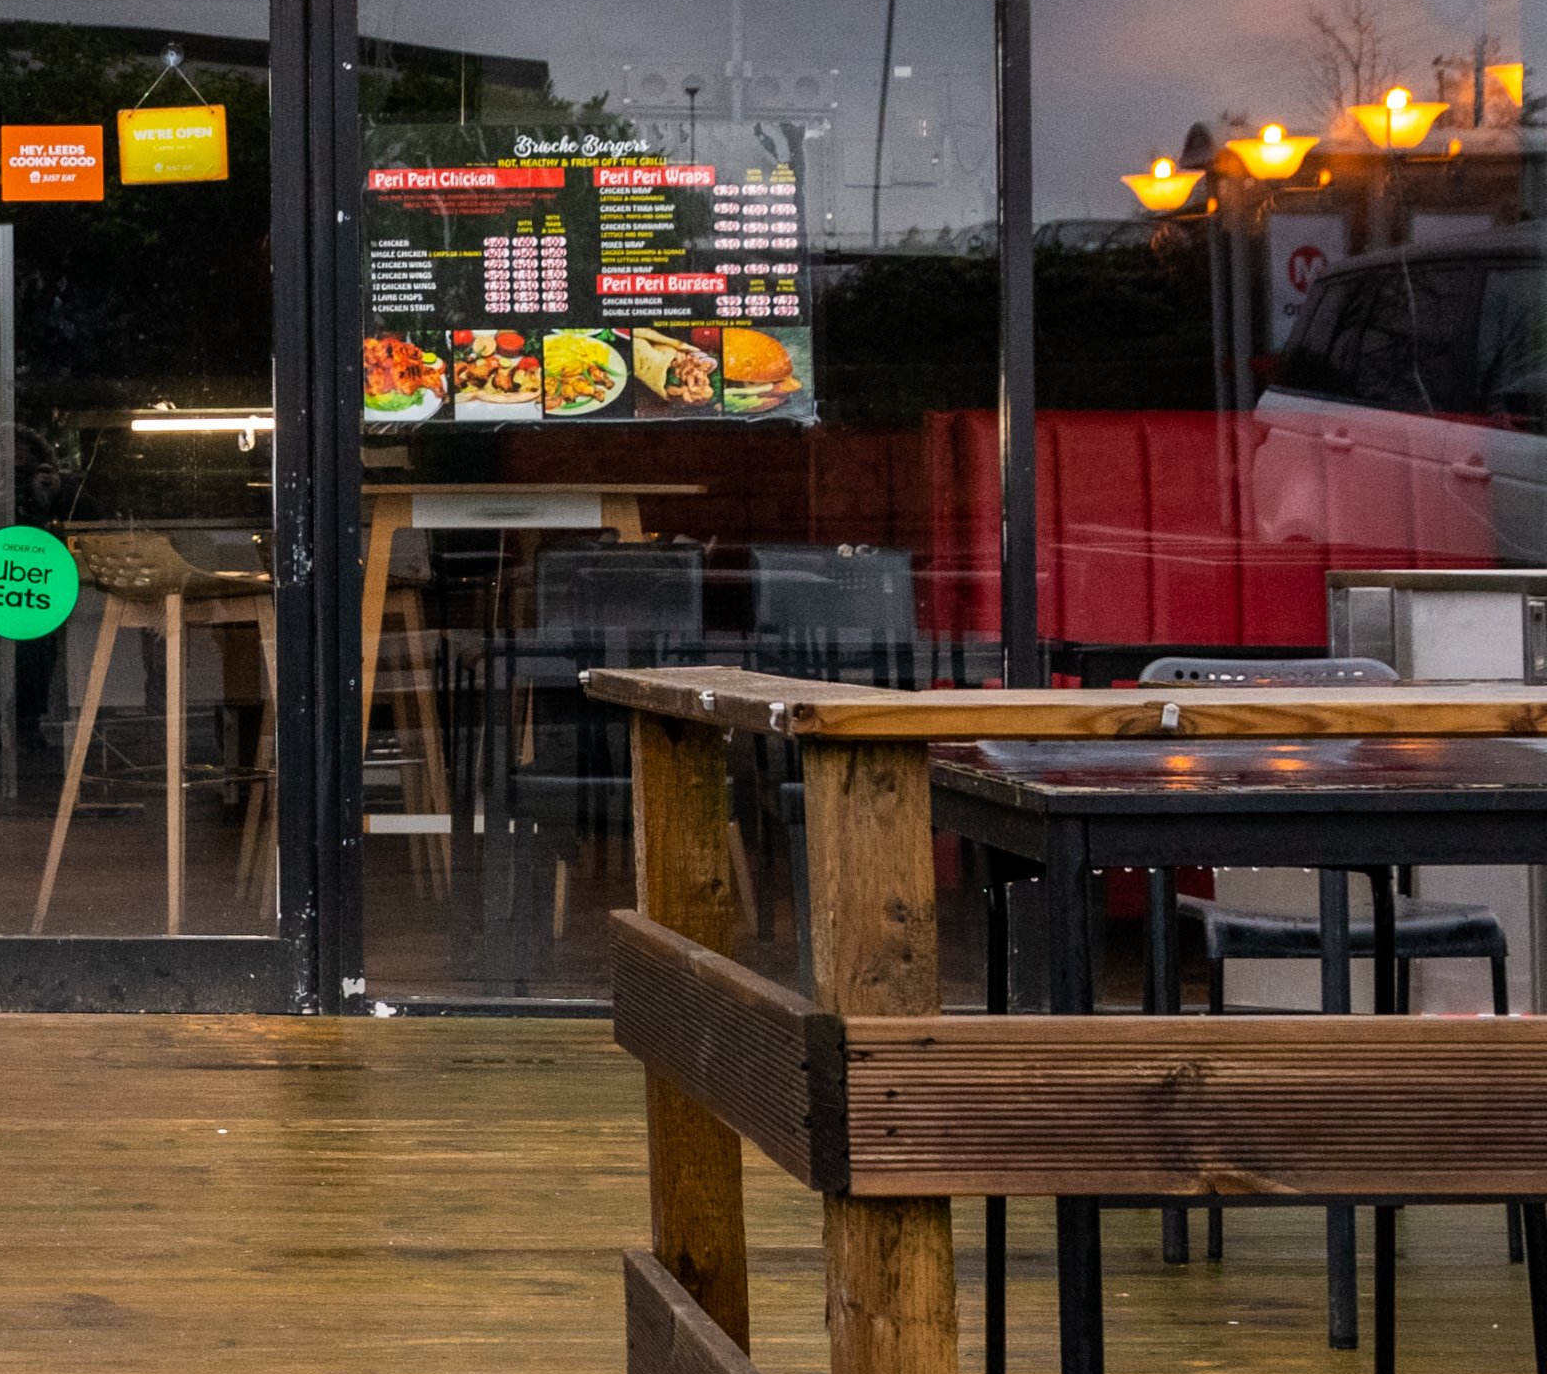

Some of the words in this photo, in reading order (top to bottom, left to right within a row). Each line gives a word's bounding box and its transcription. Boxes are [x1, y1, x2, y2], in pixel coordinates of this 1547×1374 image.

[133, 128, 173, 140] WE'RE
[176, 127, 213, 139] OPEN
[514, 134, 578, 157] Brioche
[582, 134, 651, 157] Burgers
[19, 145, 47, 157] HEY,
[48, 145, 85, 155] LEEDS
[9, 156, 58, 167] COOKIN'
[60, 156, 96, 167] GOOD
[520, 159, 558, 167] HEALTHY
[571, 158, 599, 167] FRESH
[601, 158, 617, 166] OFF
[619, 158, 637, 166] THE
[41, 174, 60, 183] JUST
[61, 173, 76, 183] EAT
[375, 172, 404, 187] Peri
[408, 172, 436, 187] Peri
[440, 172, 496, 186] Chicken
[600, 169, 628, 185] Peri
[633, 169, 661, 185] Peri
[665, 169, 711, 185] Wraps
[599, 187, 631, 195] CHICKEN
[599, 205, 631, 213] CHICKEN
[654, 204, 675, 212] WRAP
[600, 223, 631, 231] CHICKEN
[396, 250, 427, 258] CHICKEN
[377, 261, 408, 269] CHICKEN
[409, 261, 432, 269] WINGS
[632, 266, 654, 274] WRAP
[377, 272, 408, 280] CHICKEN
[409, 272, 432, 280] WINGS
[413, 282, 437, 290] WINGS
[602, 276, 631, 291] Peri
[635, 276, 664, 291] Peri
[668, 276, 724, 292] Burgers
[399, 293, 423, 301] CHOPS
[634, 297, 663, 305] BURGER
[632, 308, 663, 316] CHICKEN
[2, 543, 31, 553] ORDER
[31, 546, 45, 554] ON
